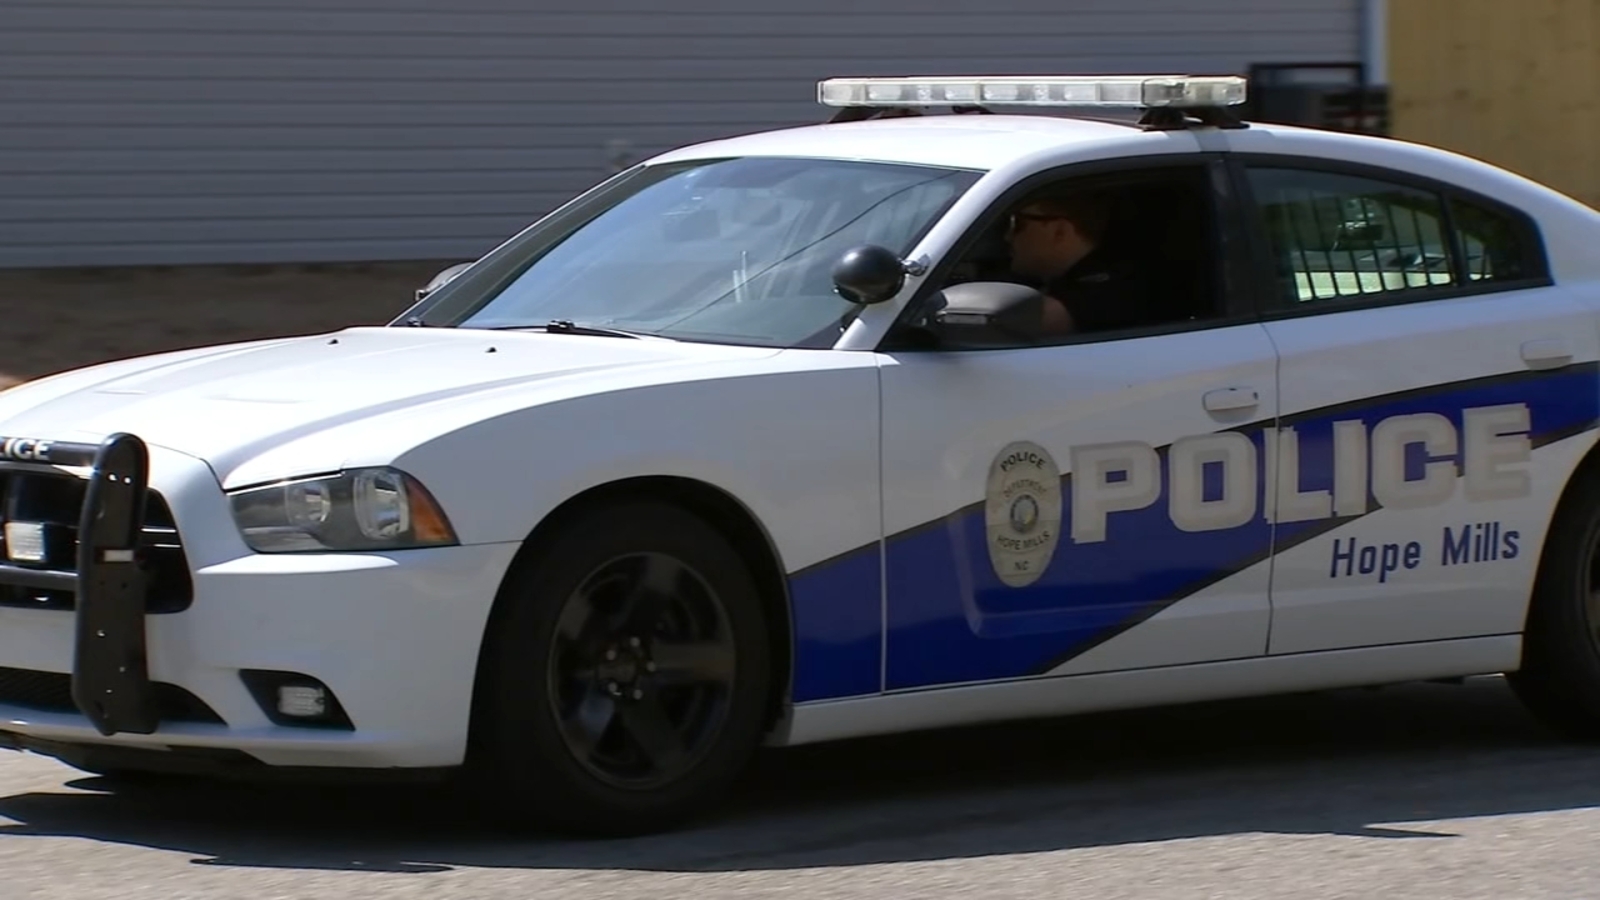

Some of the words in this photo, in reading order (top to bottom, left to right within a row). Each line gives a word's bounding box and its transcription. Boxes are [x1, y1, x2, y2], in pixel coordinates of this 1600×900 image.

[0, 438, 54, 460] ICE
[1000, 451, 1046, 472] POLICE
[1070, 403, 1532, 544] POLICE
[996, 534, 1022, 550] HOPE
[1023, 530, 1050, 549] MILLS
[1330, 537, 1421, 583] Hope
[1441, 521, 1520, 566] Mills
[1014, 560, 1030, 571] NC
